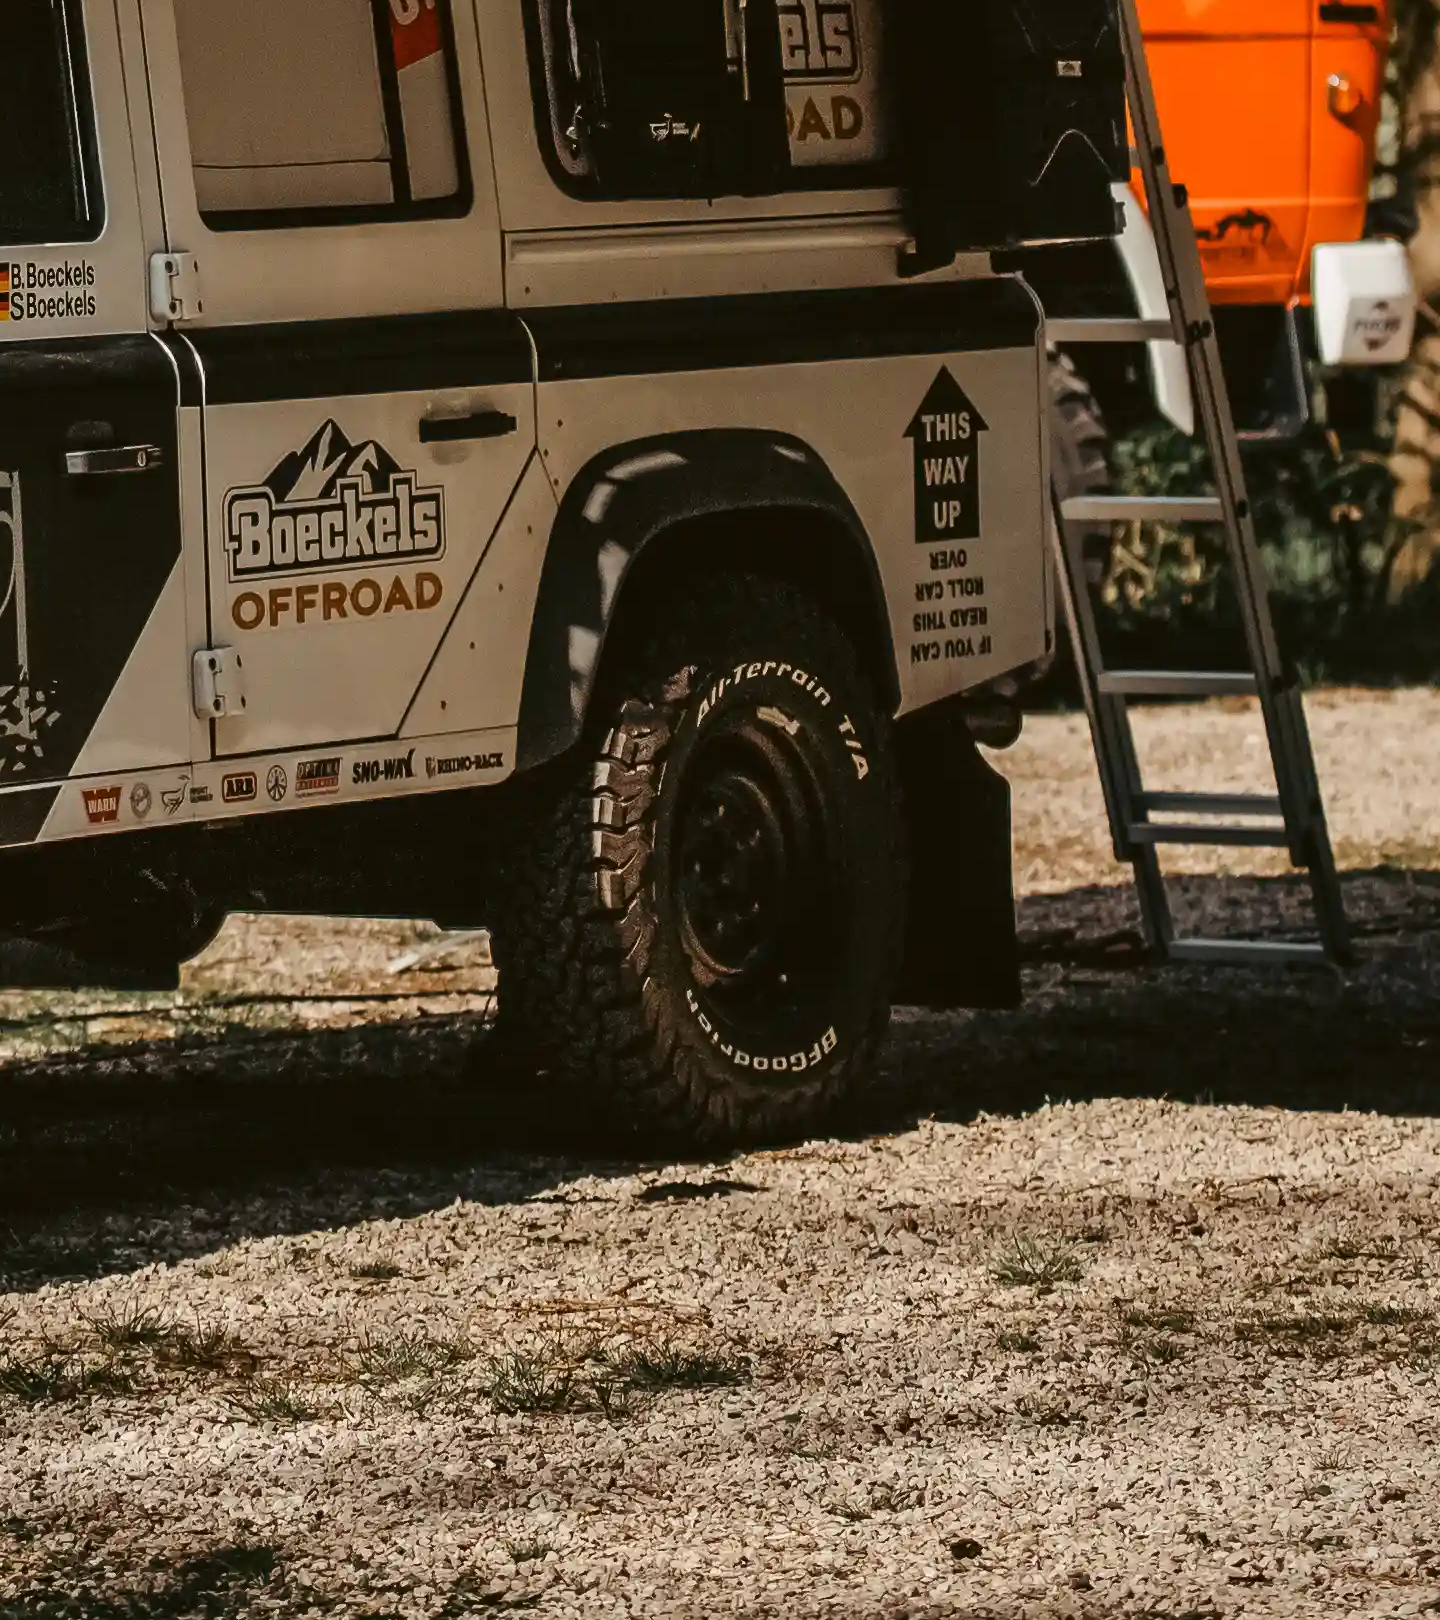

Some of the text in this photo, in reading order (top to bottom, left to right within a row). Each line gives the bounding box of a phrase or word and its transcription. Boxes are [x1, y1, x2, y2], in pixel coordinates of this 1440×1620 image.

[787, 94, 864, 142] AD
[921, 411, 971, 443] THIS
[923, 455, 970, 487] WAY
[228, 483, 439, 570] Boeckels
[933, 499, 962, 530] UP
[928, 548, 968, 571] OVER
[231, 571, 444, 631] OFFROAD
[914, 575, 985, 602] ROLL CAR
[912, 606, 988, 633] READ THIS
[910, 635, 992, 664] IF YOU CAN
[696, 660, 870, 781] All-Terrain T/A
[88, 797, 117, 814] WARN
[686, 988, 838, 1072] BFGoodrich
